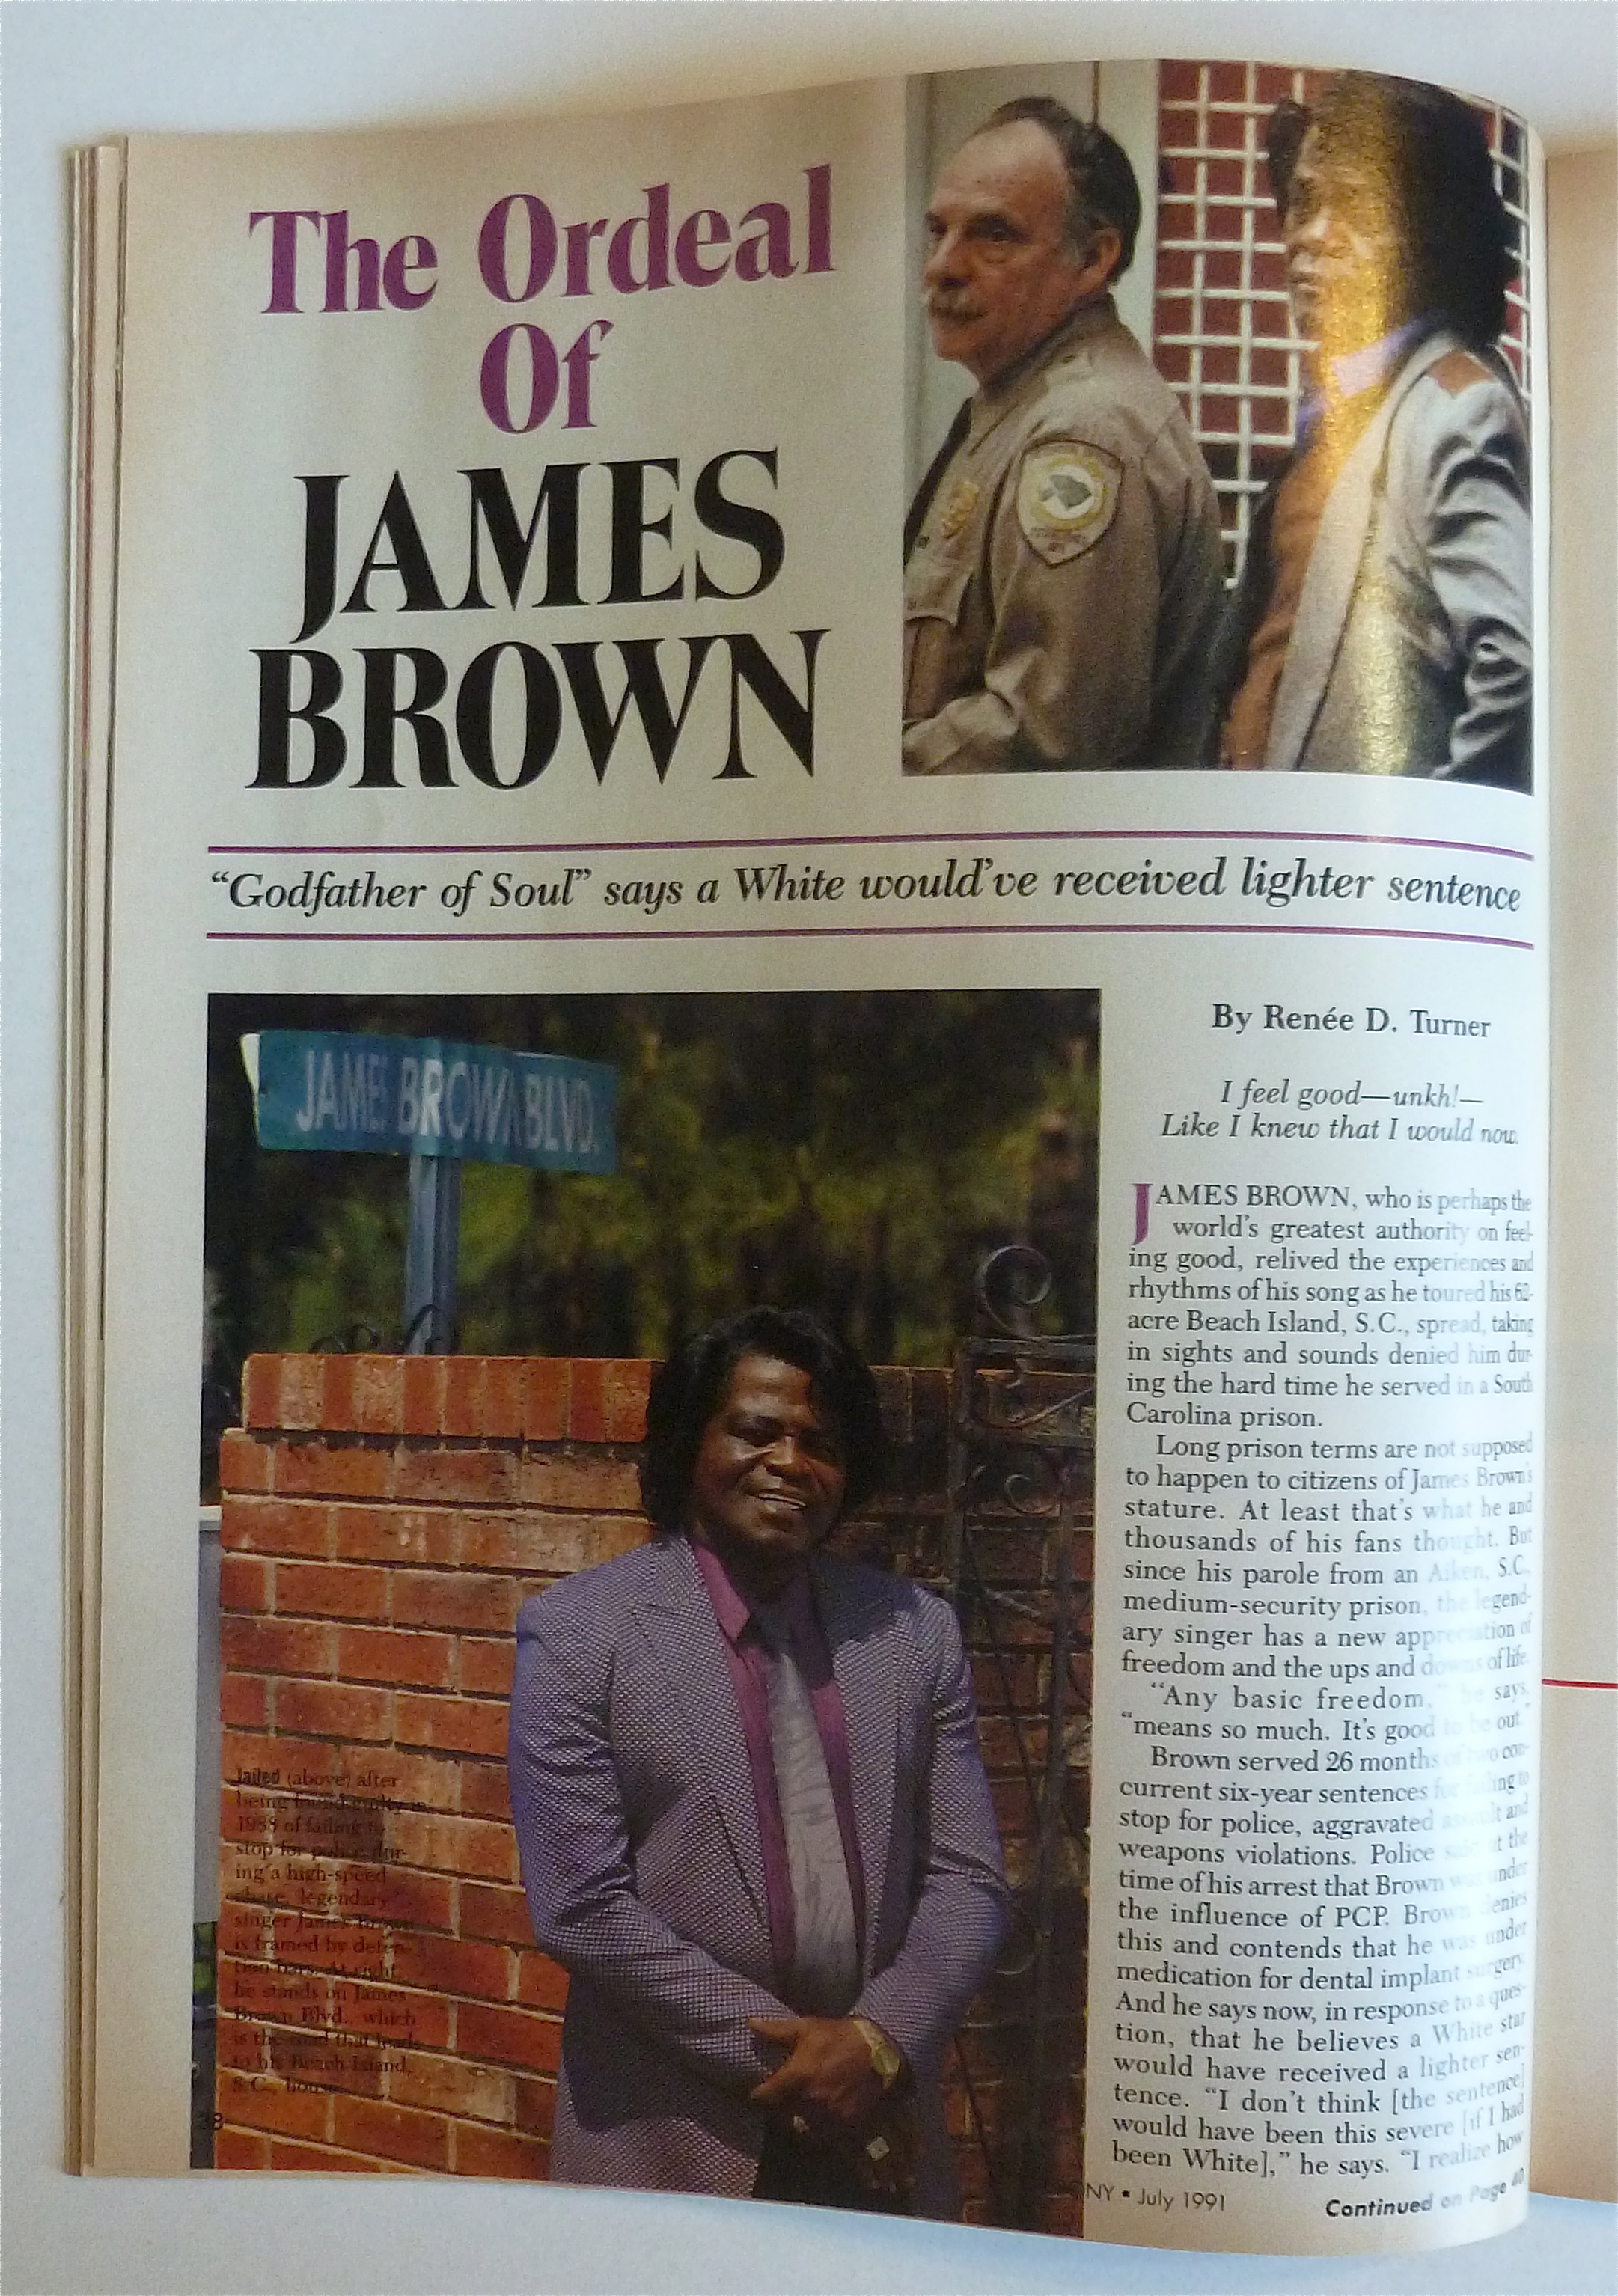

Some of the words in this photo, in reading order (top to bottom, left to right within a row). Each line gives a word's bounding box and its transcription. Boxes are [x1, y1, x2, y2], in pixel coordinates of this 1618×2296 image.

[248, 210, 439, 314] The
[477, 163, 837, 302] Ordeal
[480, 320, 614, 433] Of
[289, 446, 785, 644] JAMES
[245, 629, 831, 790] BROWN
[211, 870, 427, 917] “Godfather
[441, 870, 483, 917] of
[490, 867, 592, 908] Soul”
[604, 876, 682, 915] says
[697, 879, 720, 903] a
[736, 864, 845, 903] White
[858, 858, 1037, 899] would’ve
[1054, 857, 1227, 897] received
[1243, 857, 1375, 908] lighter
[1388, 872, 1521, 912] sentence
[1212, 1004, 1252, 1034] By
[1263, 1004, 1353, 1031] Renée
[1365, 1007, 1397, 1033] D.
[1409, 1010, 1491, 1037] Turner
[398, 1057, 522, 1148] BROWN
[1221, 1081, 1233, 1103] I
[1236, 1078, 1289, 1111] feel
[1161, 1111, 1219, 1138] Like
[1229, 1114, 1241, 1137] I
[1251, 1112, 1319, 1138] knew
[1329, 1114, 1380, 1140] that
[1388, 1117, 1399, 1140] I
[1408, 1117, 1474, 1143] would
[1246, 1185, 1359, 1212] BROWN,
[1365, 1185, 1411, 1209] who
[1173, 1215, 1259, 1238] world’s
[1271, 1219, 1365, 1244] greatest
[1129, 1248, 1167, 1272] ing
[1176, 1245, 1243, 1273] good,
[1255, 1247, 1338, 1271] relived
[1349, 1248, 1385, 1271] the
[1129, 1275, 1231, 1304] rhythms
[1237, 1277, 1263, 1300] of
[1266, 1277, 1299, 1301] his
[1128, 1315, 1179, 1330] acre
[1186, 1309, 1260, 1331] Beach
[1267, 1310, 1346, 1337] Island,
[1355, 1312, 1409, 1336] S.C.,
[1127, 1340, 1150, 1361] in
[1162, 1340, 1232, 1368] sights
[1244, 1340, 1287, 1363] and
[1127, 1373, 1165, 1399] ing
[1173, 1370, 1212, 1393] the
[1126, 1402, 1231, 1426] Carolina
[1239, 1405, 1322, 1432] prison.
[1156, 1434, 1220, 1462] Long
[1227, 1437, 1303, 1462] prison
[1126, 1467, 1149, 1486] to
[1156, 1464, 1248, 1494] happen
[1257, 1470, 1280, 1489] to
[1288, 1467, 1377, 1490] citizens
[1124, 1499, 1225, 1520] stature.
[1239, 1499, 1269, 1521] At
[1281, 1498, 1340, 1521] least
[1125, 1525, 1256, 1551] thousands
[1123, 1560, 1185, 1581] since
[1197, 1559, 1231, 1583] his
[1243, 1561, 1319, 1588] parole
[1123, 1589, 1341, 1620] medium-security
[1123, 1626, 1163, 1647] ary
[1174, 1624, 1253, 1650] singer
[1121, 1649, 1225, 1676] freedom
[1233, 1652, 1276, 1678] and
[1151, 1682, 1218, 1714] “Any
[1233, 1684, 1302, 1709] basic
[1121, 1712, 1212, 1738] “means
[1221, 1723, 1247, 1739] so
[1256, 1718, 1330, 1741] much.
[1150, 1745, 1230, 1771] Brown
[1238, 1747, 1319, 1772] served
[1325, 1750, 1353, 1772] 26
[357, 1769, 400, 1788] after
[1119, 1780, 1212, 1801] current
[1218, 1781, 1312, 1807] six-year
[1319, 1784, 1427, 1804] sentences
[1119, 1809, 1170, 1834] stop
[1179, 1808, 1212, 1831] for
[1221, 1810, 1301, 1839] police,
[1118, 1842, 1224, 1866] weapons
[1236, 1842, 1357, 1866] violations.
[236, 1863, 266, 1883] ing
[270, 1868, 280, 1880] a
[1118, 1869, 1173, 1892] time
[1179, 1870, 1206, 1893] of
[1118, 1896, 1158, 1920] the
[1171, 1902, 1287, 1927] influence
[1300, 1905, 1326, 1928] of
[1334, 1905, 1390, 1928] PCP.
[1117, 1928, 1162, 1952] this
[1173, 1932, 1218, 1955] and
[1230, 1935, 1341, 1959] contends
[1117, 1959, 1251, 1988] medication
[1260, 1964, 1292, 1989] for
[1299, 1966, 1373, 1990] dental
[1115, 1991, 1165, 2014] And
[1172, 1992, 1201, 2016] he
[1115, 2022, 1174, 2048] tion,
[1191, 2024, 1240, 2050] that
[1254, 2027, 1283, 2051] he
[1297, 2028, 1399, 2051] believes
[1114, 2054, 1192, 2077] would
[1206, 2056, 1265, 2081] have
[1279, 2057, 1385, 2083] received
[1114, 2083, 1189, 2107] tence.
[1205, 2086, 1228, 2110] “I
[1242, 2089, 1305, 2113] don’t
[1318, 2088, 1380, 2113] think
[1112, 2114, 1187, 2138] would
[1198, 2116, 1254, 2142] have
[1265, 2119, 1323, 2144] been
[1112, 2140, 1171, 2168] been
[1182, 2146, 1290, 2177] White],”
[1300, 2151, 1328, 2175] he
[1338, 2158, 1389, 2180] says.
[1137, 2188, 1174, 2212] July
[1184, 2192, 1225, 2212] 1991
[1325, 2193, 1434, 2217] Continued
[1470, 2181, 1507, 2203] Page
